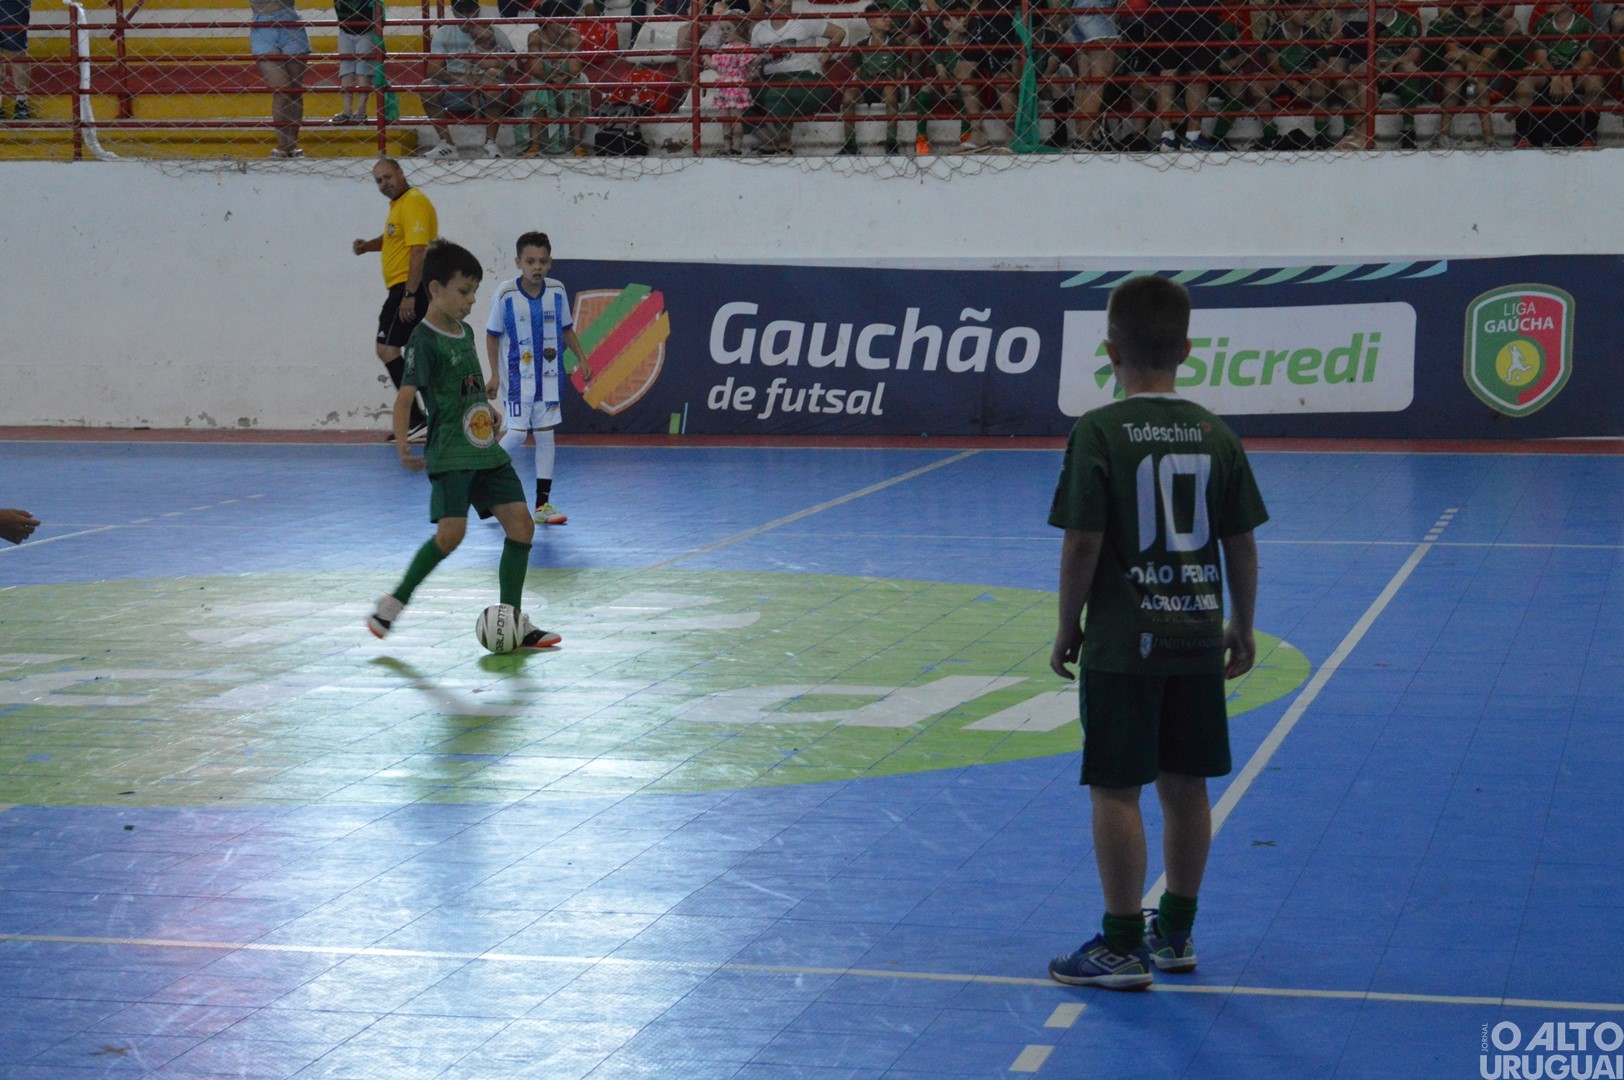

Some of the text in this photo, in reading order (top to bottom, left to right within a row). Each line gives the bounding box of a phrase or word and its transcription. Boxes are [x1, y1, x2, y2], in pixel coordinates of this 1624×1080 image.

[1484, 315, 1554, 333] GAÚCHA
[1503, 302, 1537, 316] LIGA
[709, 301, 1042, 375] Gauchão
[1174, 332, 1382, 387] Sicredi
[707, 377, 886, 420] de futsal
[1122, 422, 1203, 443] Todeschini
[1136, 453, 1212, 552] 10
